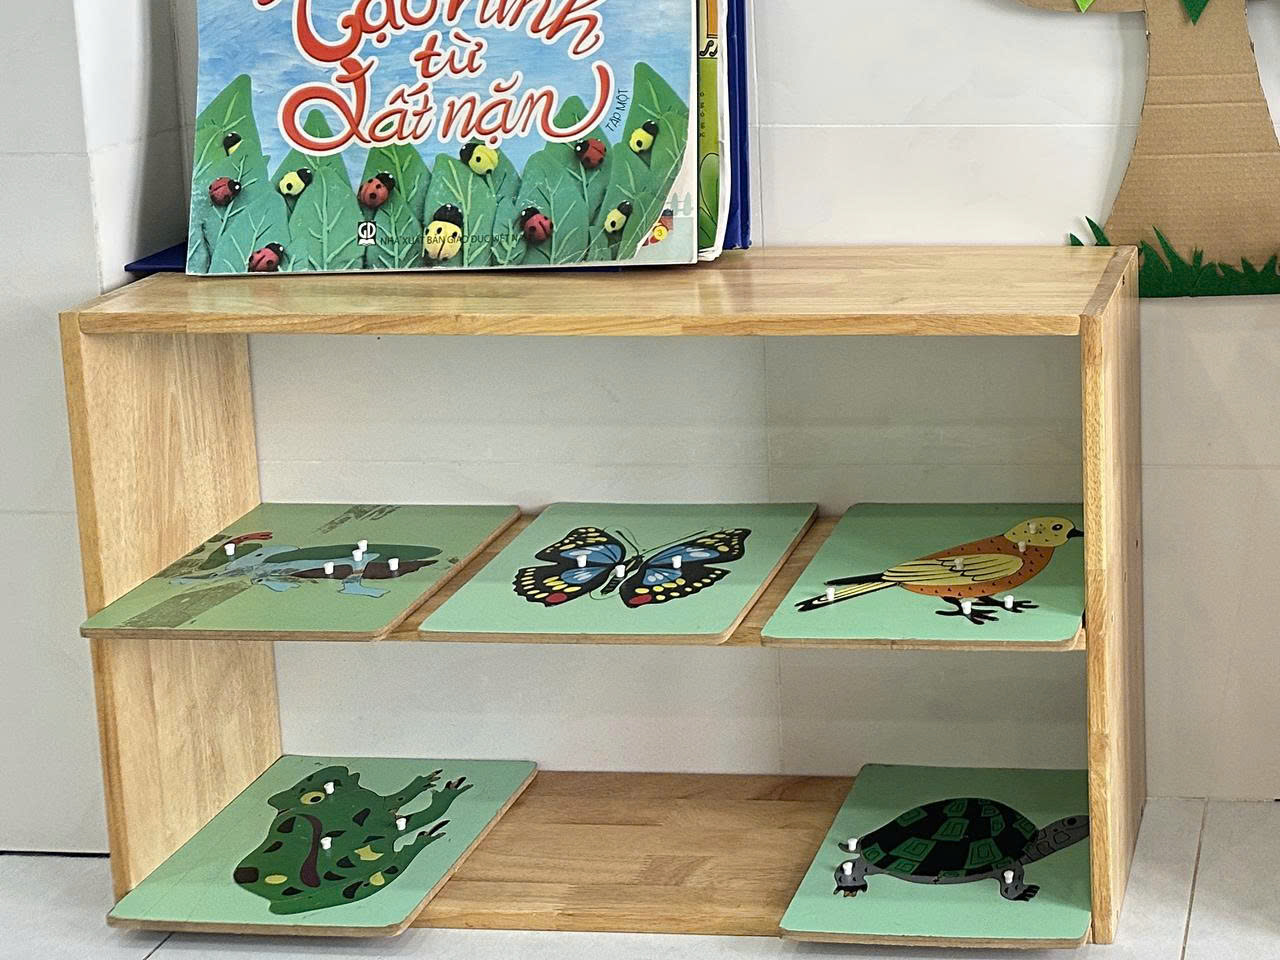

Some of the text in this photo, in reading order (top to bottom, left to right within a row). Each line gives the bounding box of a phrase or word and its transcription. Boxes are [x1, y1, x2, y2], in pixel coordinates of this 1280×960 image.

[413, 33, 484, 80] từ
[441, 74, 613, 146] nặn
[615, 87, 630, 111] MỘT
